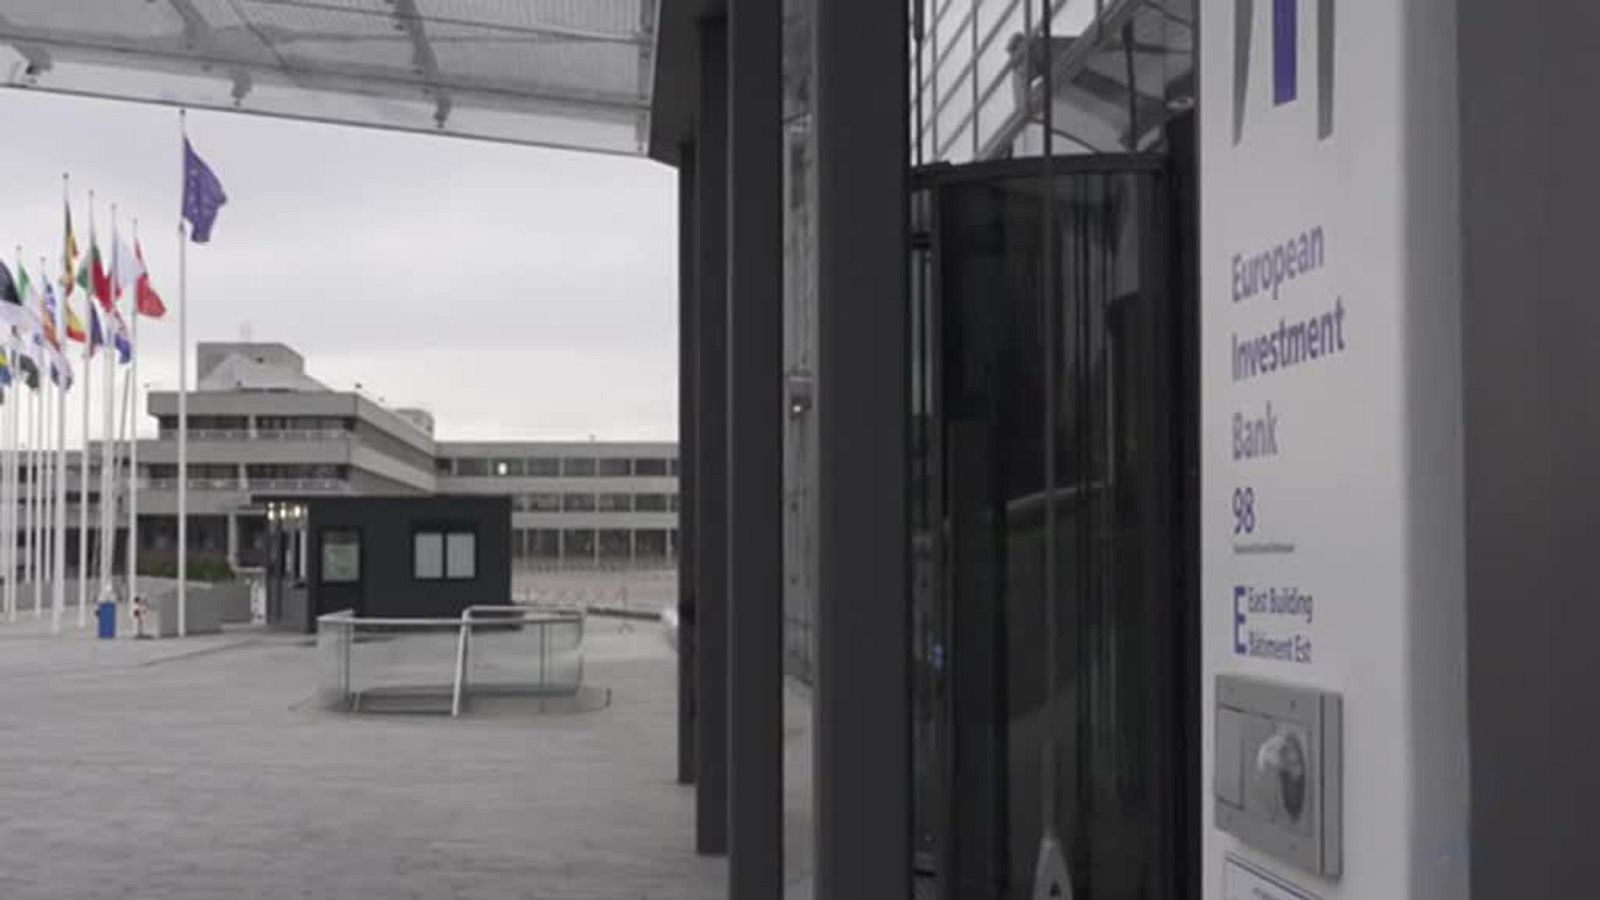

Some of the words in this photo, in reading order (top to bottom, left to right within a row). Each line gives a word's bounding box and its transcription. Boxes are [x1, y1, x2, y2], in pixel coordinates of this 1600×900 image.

[1232, 225, 1324, 303] European
[1232, 296, 1345, 382] Investment
[1232, 400, 1278, 460] Bank
[1232, 487, 1255, 534] 98
[1233, 586, 1247, 655] E
[1269, 587, 1313, 624] Building
